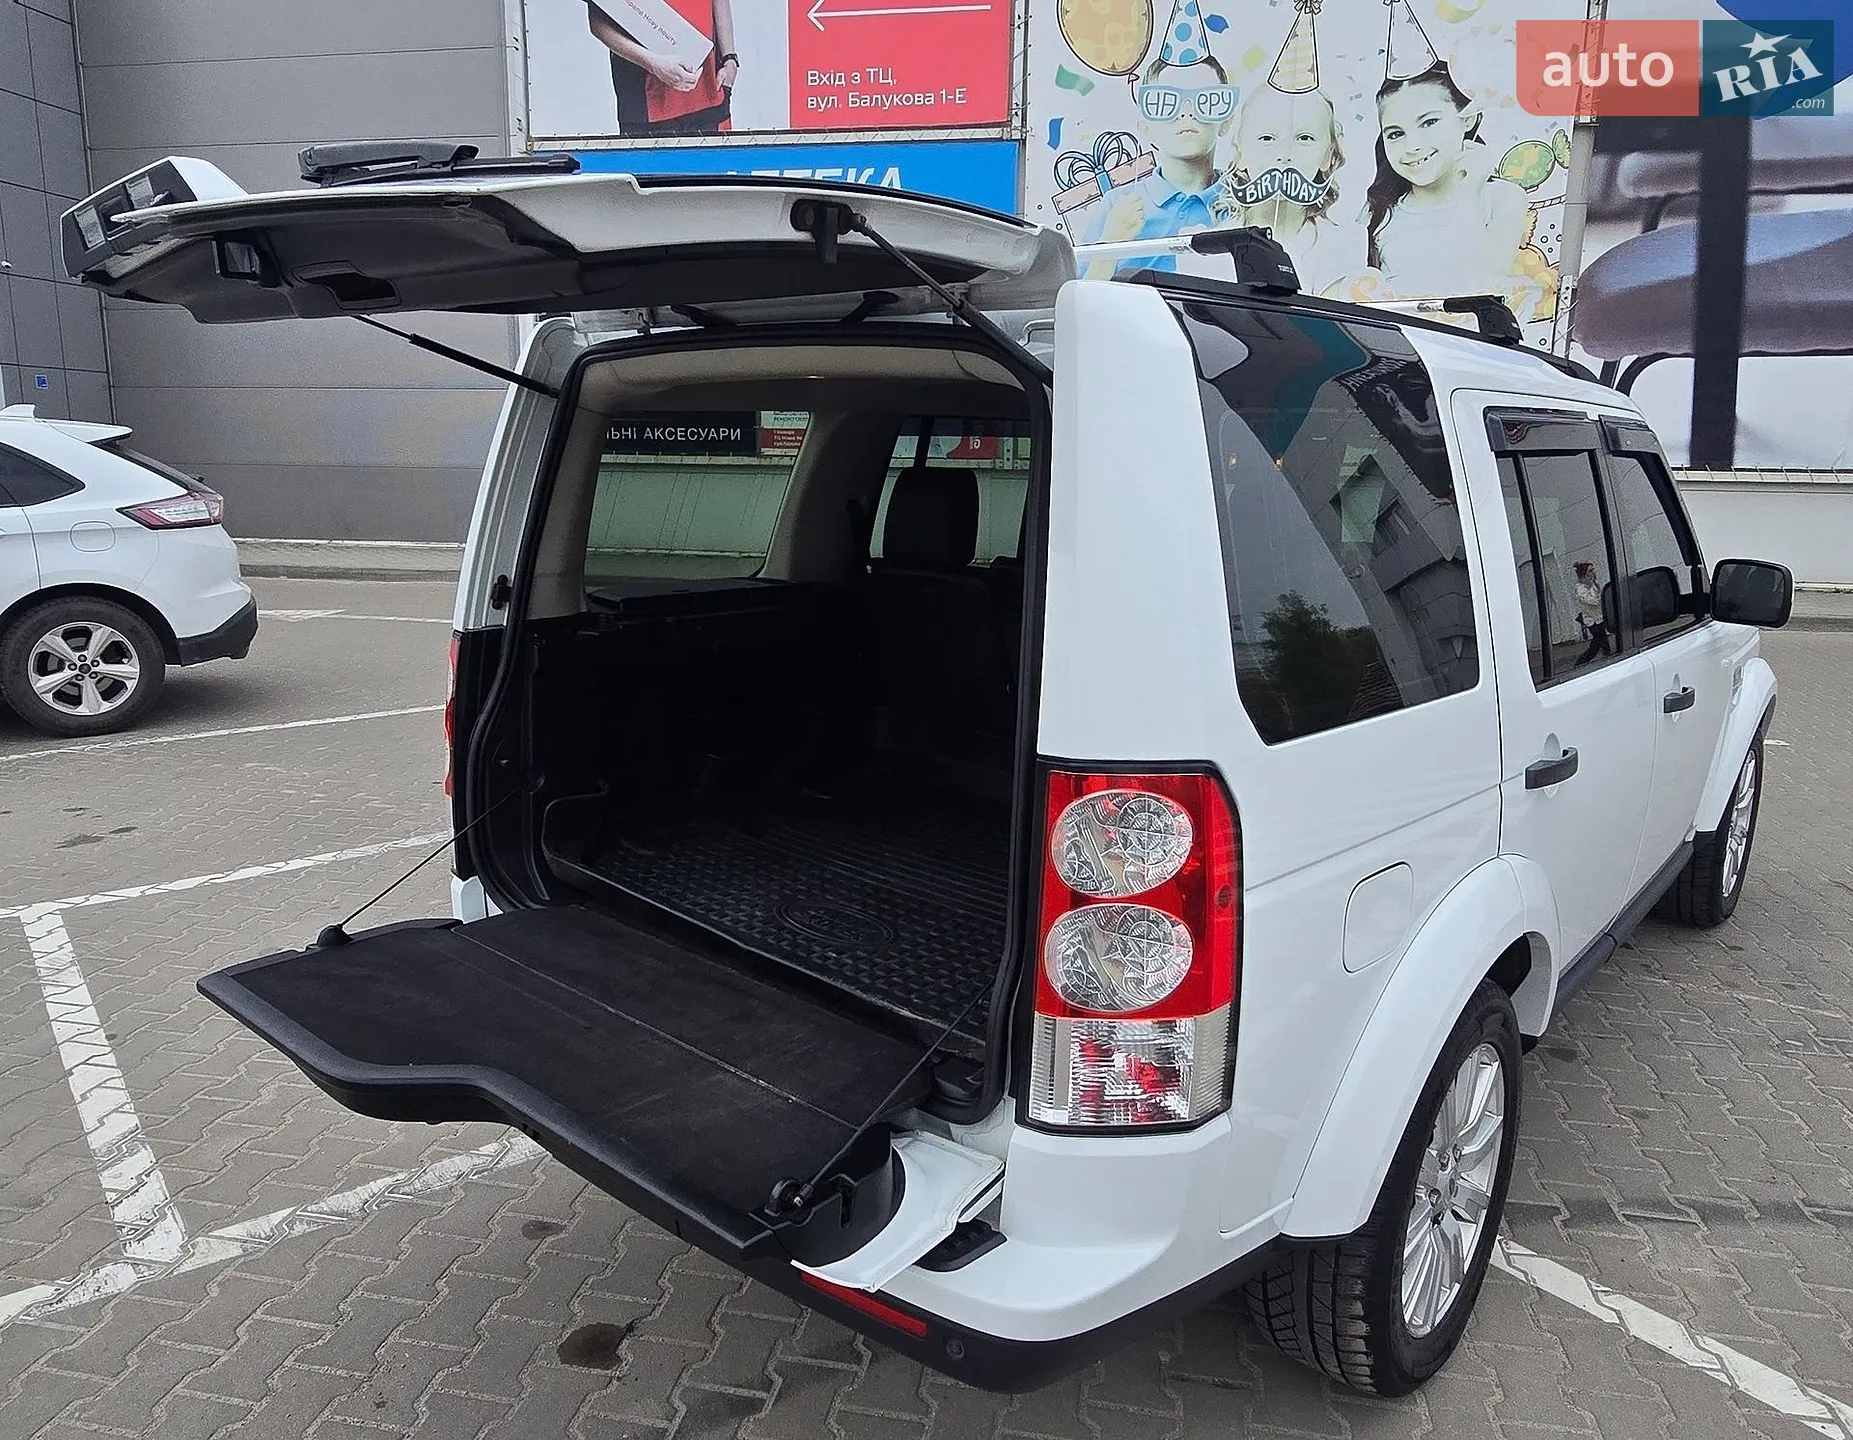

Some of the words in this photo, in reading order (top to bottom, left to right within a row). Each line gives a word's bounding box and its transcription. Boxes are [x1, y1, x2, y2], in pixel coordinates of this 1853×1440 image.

[657, 26, 678, 46] пошту
[807, 70, 846, 87] Вхід
[850, 72, 861, 84] з
[865, 67, 897, 87] ТЦ,
[807, 96, 843, 112] вул.
[848, 92, 935, 110] Балукова
[643, 427, 742, 441] АКСЕСУАРИ
